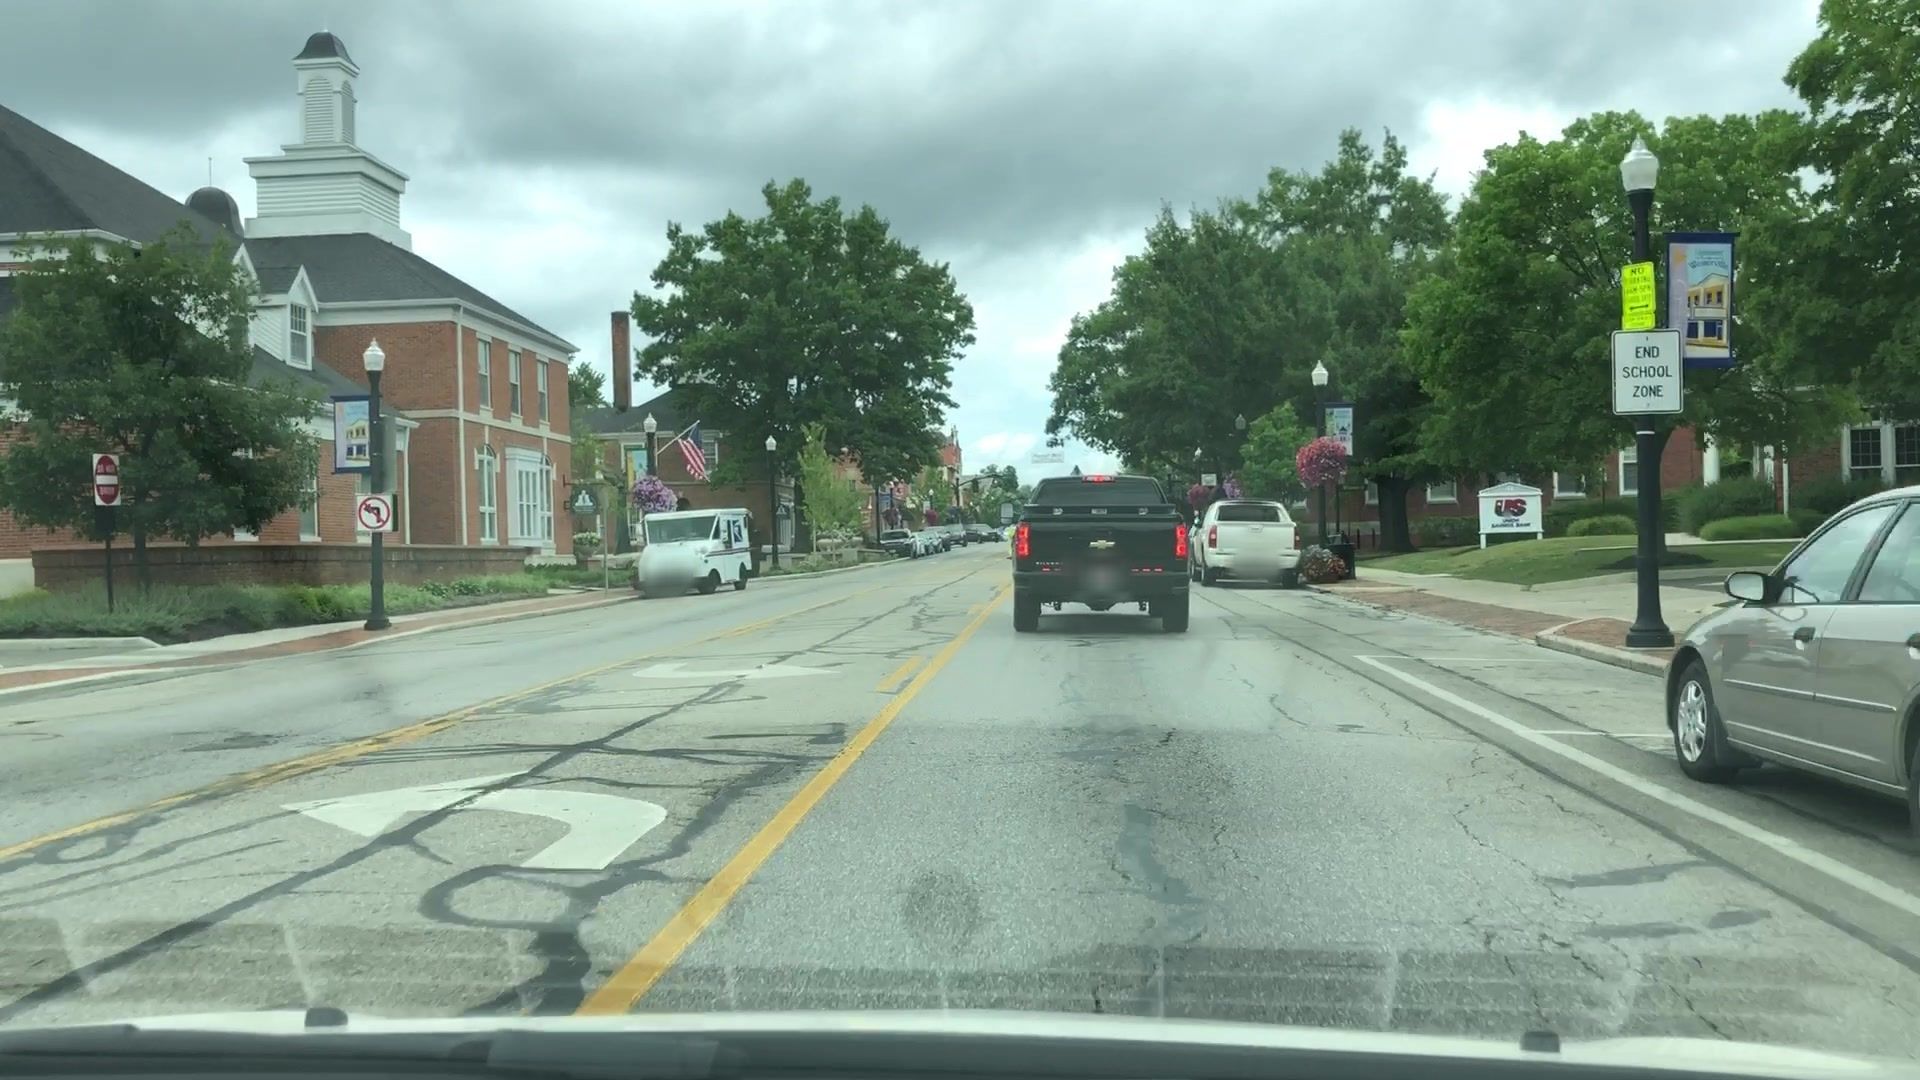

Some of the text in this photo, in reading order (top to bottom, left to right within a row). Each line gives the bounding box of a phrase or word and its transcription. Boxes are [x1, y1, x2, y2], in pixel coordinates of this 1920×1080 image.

[1630, 267, 1644, 275] NO
[1635, 346, 1659, 358] END
[1622, 366, 1672, 378] SCHOOL
[1632, 385, 1663, 398] ZONE
